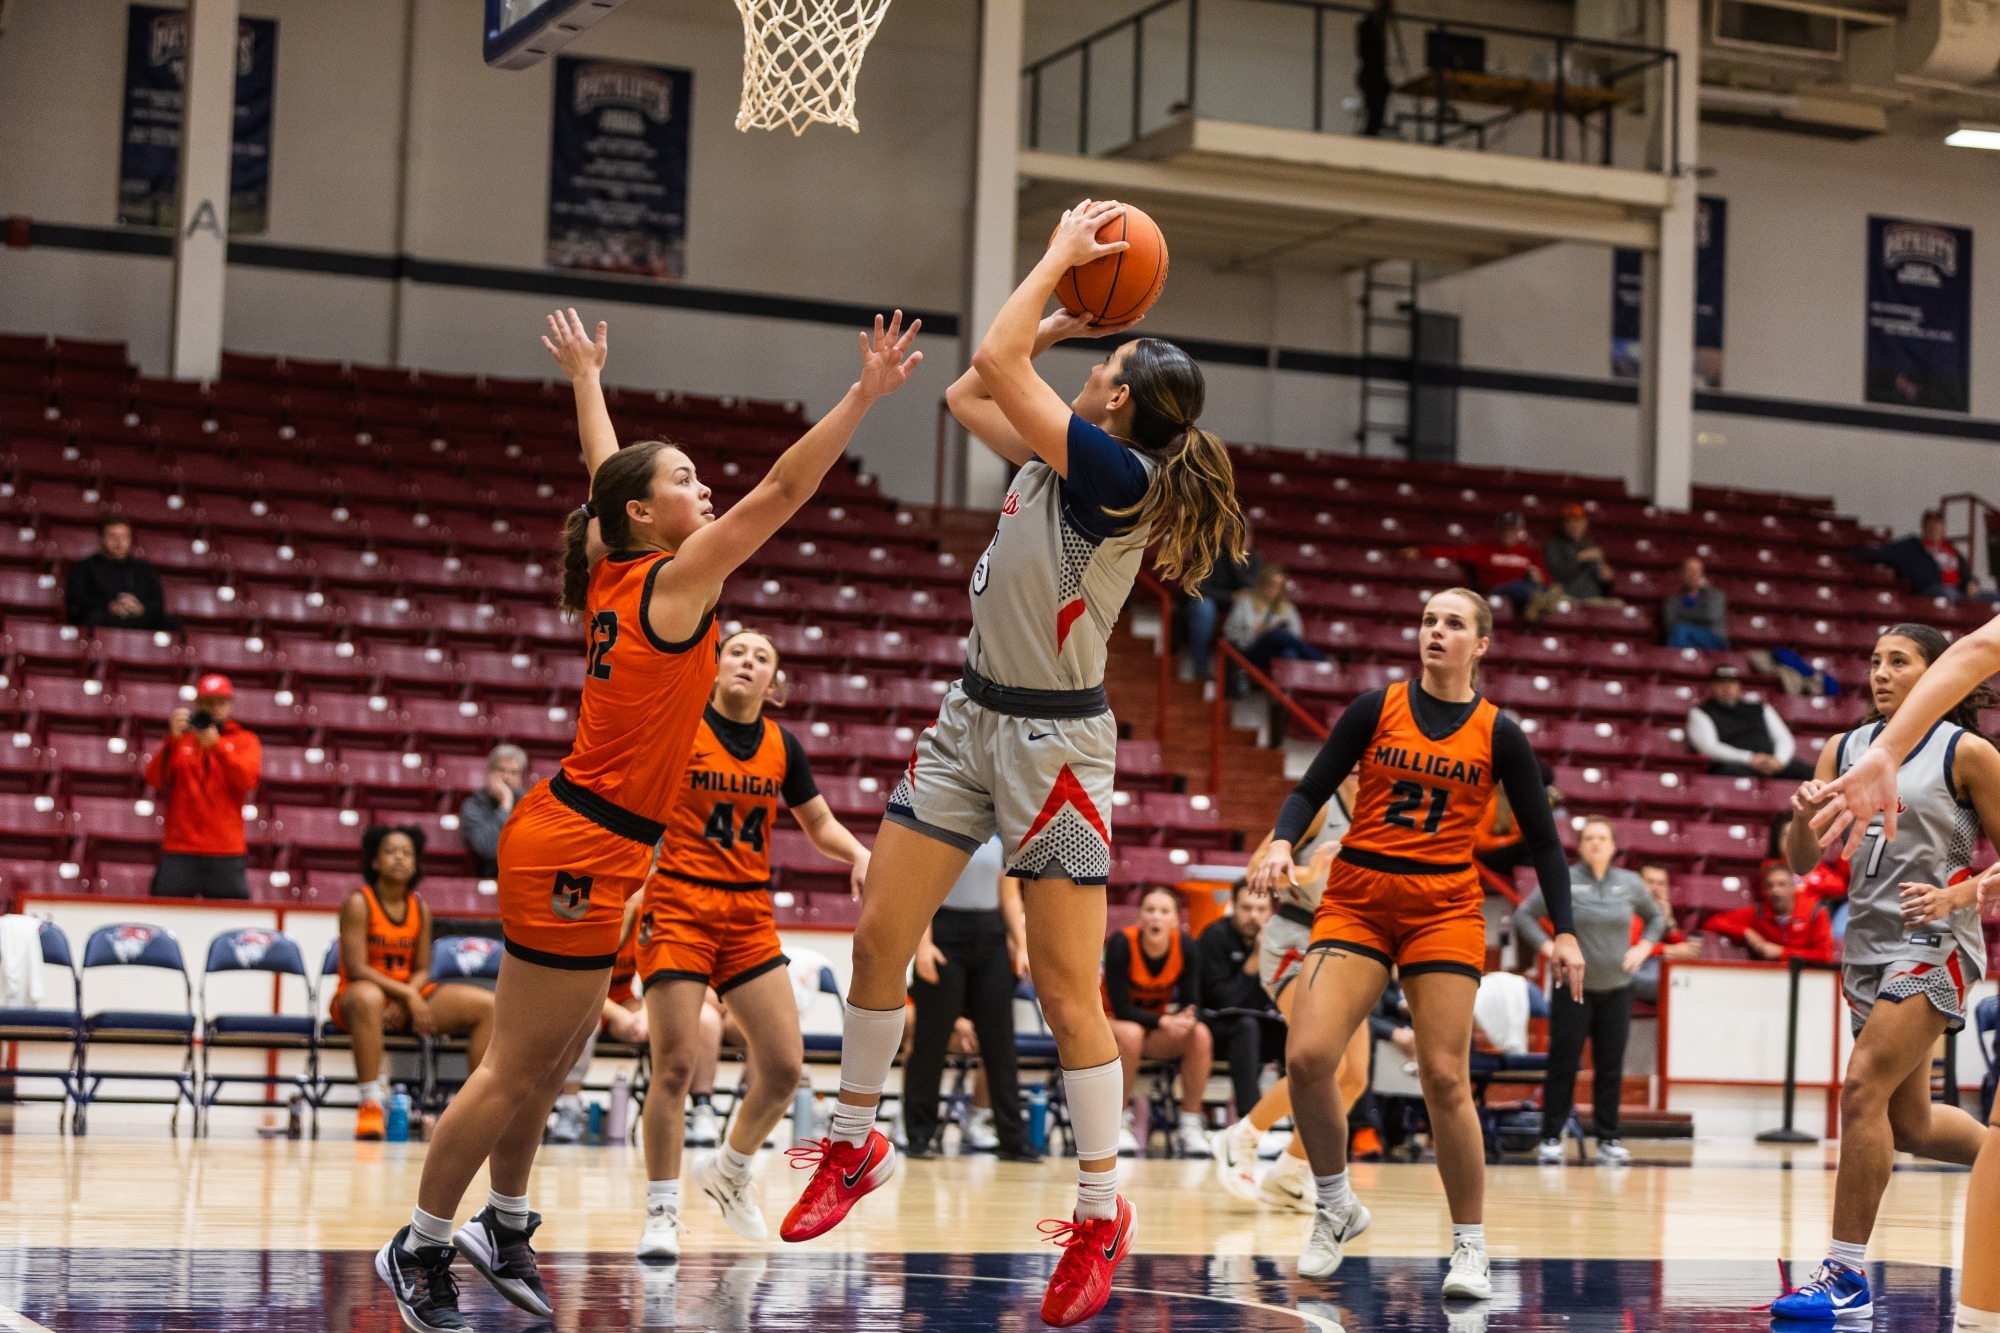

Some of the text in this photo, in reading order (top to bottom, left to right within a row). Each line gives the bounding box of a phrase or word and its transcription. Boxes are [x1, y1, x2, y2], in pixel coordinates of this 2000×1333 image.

[186, 199, 223, 239] A
[1373, 745, 1482, 787] MILLIGAN
[703, 801, 768, 853] 44
[1383, 779, 1450, 835] 21
[1865, 824, 1888, 878] 7
